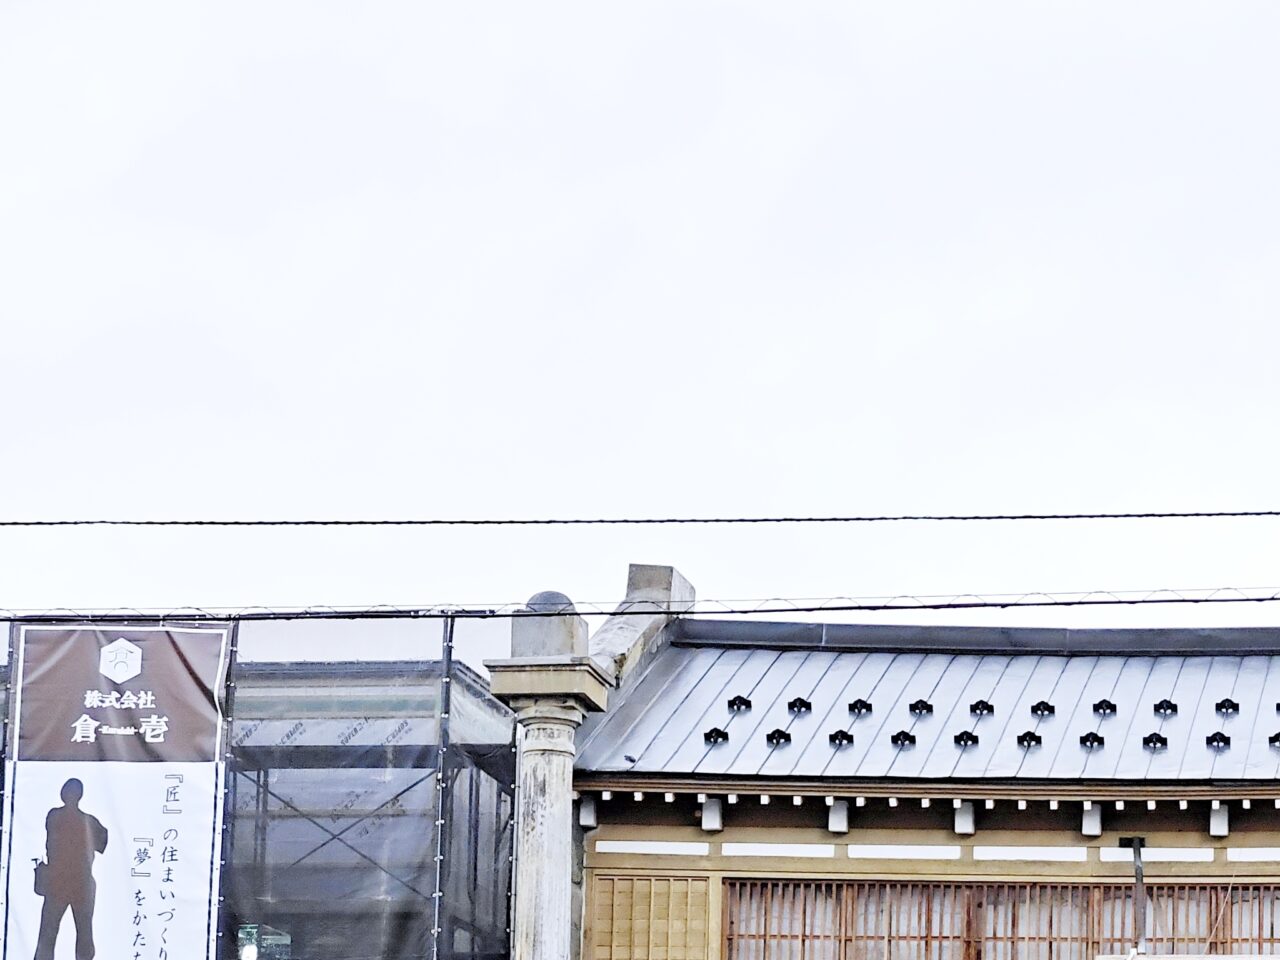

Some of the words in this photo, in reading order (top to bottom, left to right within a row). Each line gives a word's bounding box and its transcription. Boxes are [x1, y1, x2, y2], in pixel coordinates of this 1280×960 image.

[84, 690, 156, 709] 株式会社
[70, 713, 101, 743] 倉
